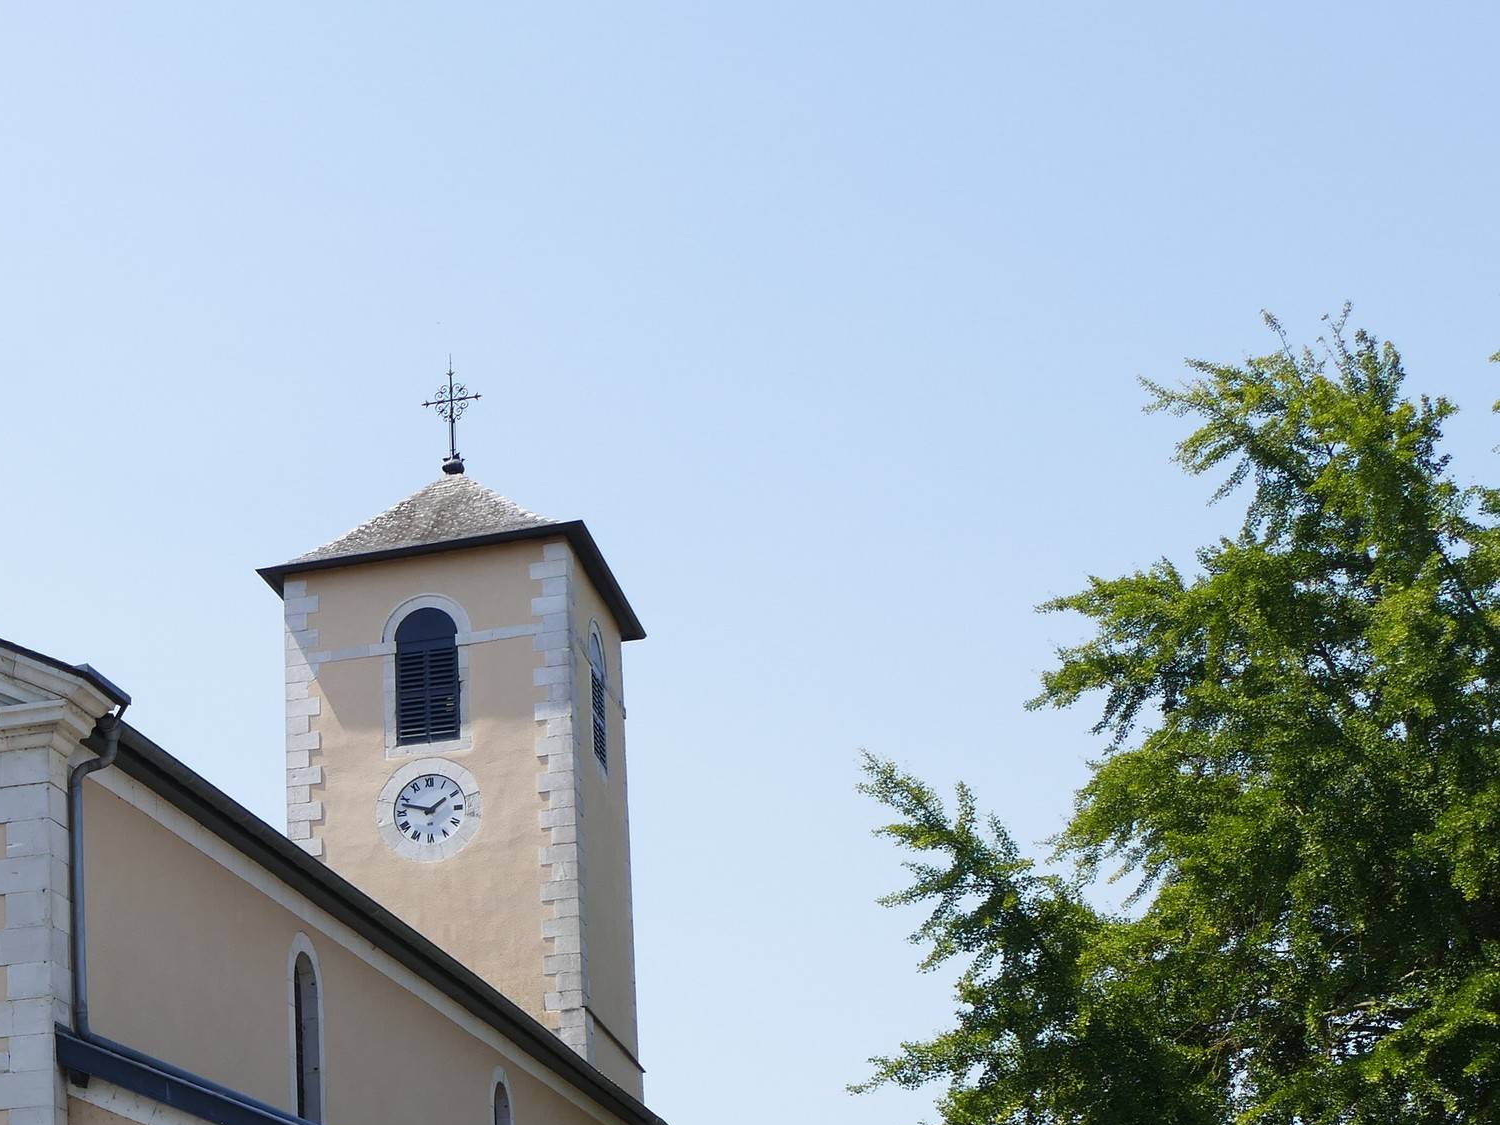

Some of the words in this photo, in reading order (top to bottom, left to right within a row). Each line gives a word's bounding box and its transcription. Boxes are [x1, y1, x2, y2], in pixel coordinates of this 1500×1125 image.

[425, 777, 434, 787] XII
[410, 782, 420, 793] XI
[397, 809, 407, 817] IX
[400, 821, 411, 833] VIII
[450, 817, 460, 827] IV
[411, 830, 421, 842] VII
[428, 833, 435, 843] VI
[442, 829, 449, 838] V
